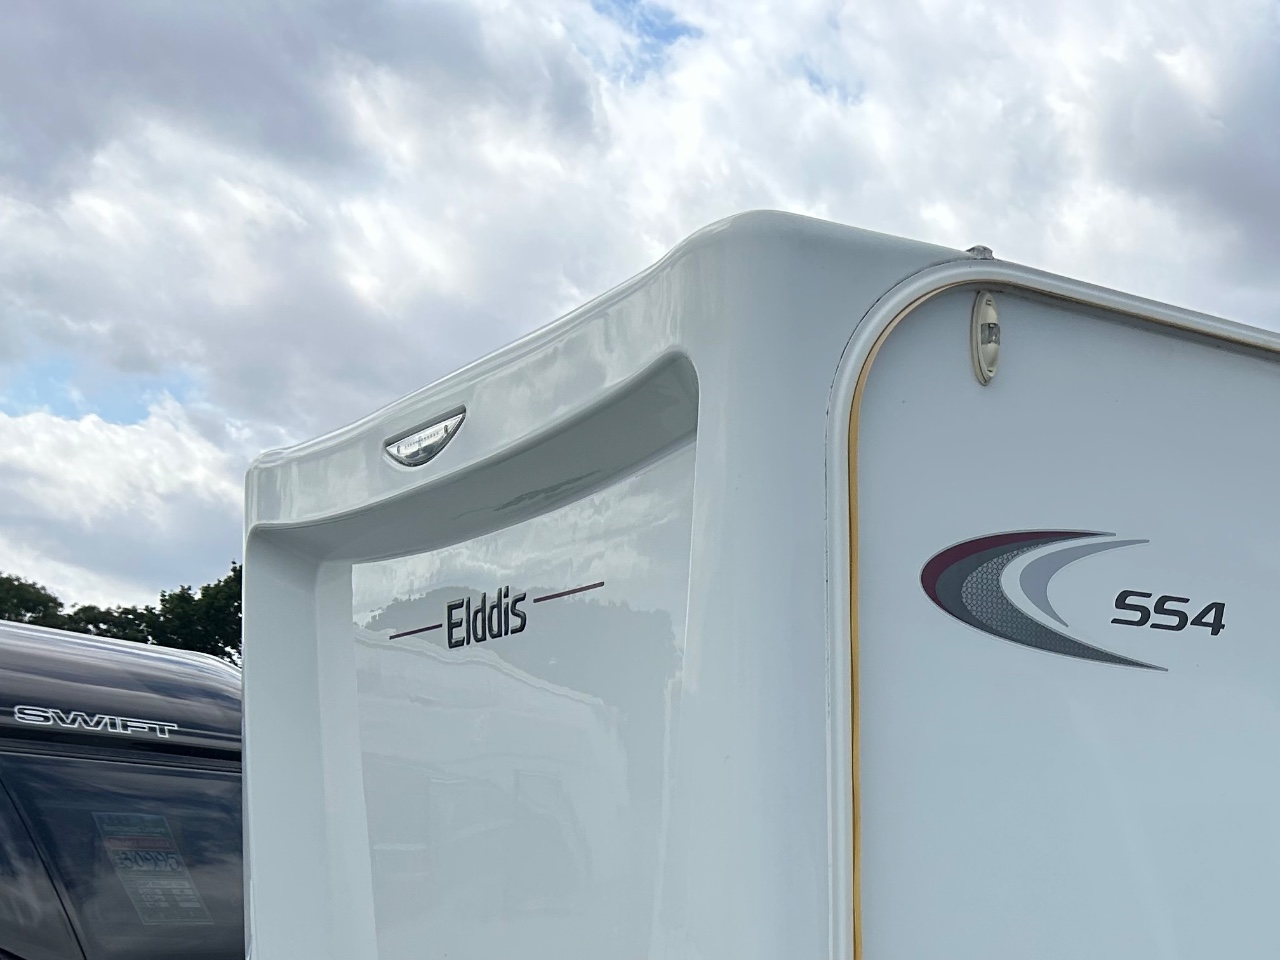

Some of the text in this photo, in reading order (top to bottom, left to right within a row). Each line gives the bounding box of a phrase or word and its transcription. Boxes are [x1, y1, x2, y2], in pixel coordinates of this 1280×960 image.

[447, 585, 527, 649] Elddis
[1110, 590, 1226, 636] SS4
[14, 705, 179, 738] SWIFT
